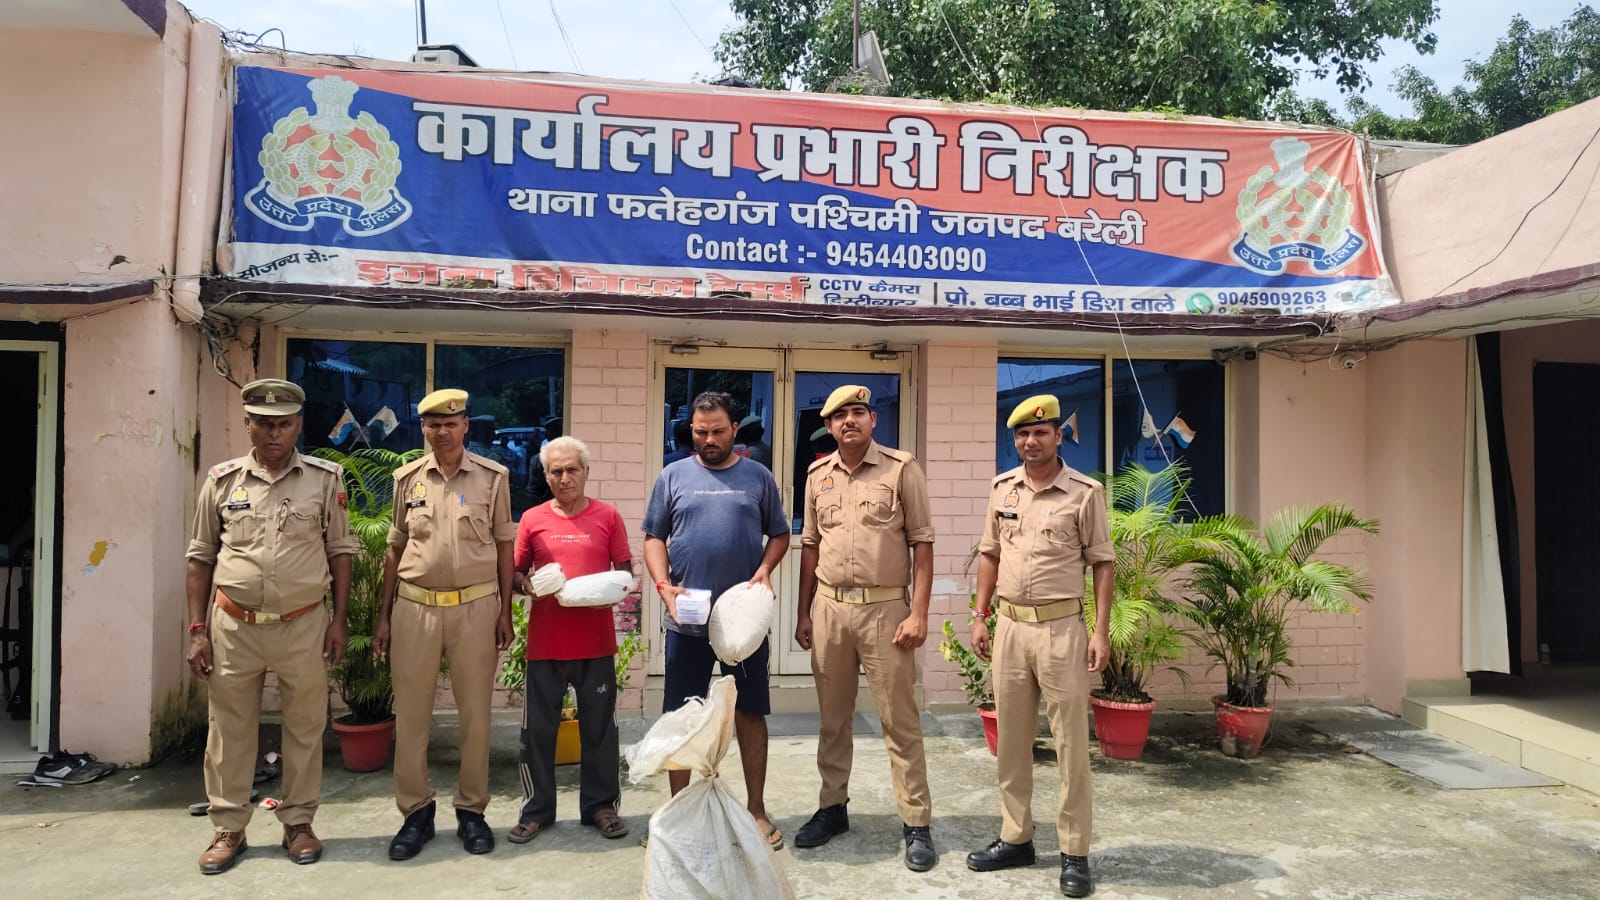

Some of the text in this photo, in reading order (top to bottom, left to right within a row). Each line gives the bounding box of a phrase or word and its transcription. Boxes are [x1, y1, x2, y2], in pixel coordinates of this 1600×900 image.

[412, 94, 1229, 202] कार्यालय प्रभारी निरीक्षक
[259, 196, 402, 231] उत्तर प्रदेश पुलिस
[507, 186, 1147, 245] थाना फतेहगंज पश्चिमी जनपद बरेली
[686, 233, 788, 263] Contact
[826, 240, 987, 273] 9454403090
[1239, 237, 1360, 270] उत्तर प्रदेश पुलिस
[819, 278, 921, 294] CCTV कैमरा
[1032, 290, 1075, 311] भाई
[1130, 293, 1176, 312] वाले
[1217, 290, 1327, 306] 9045909263
